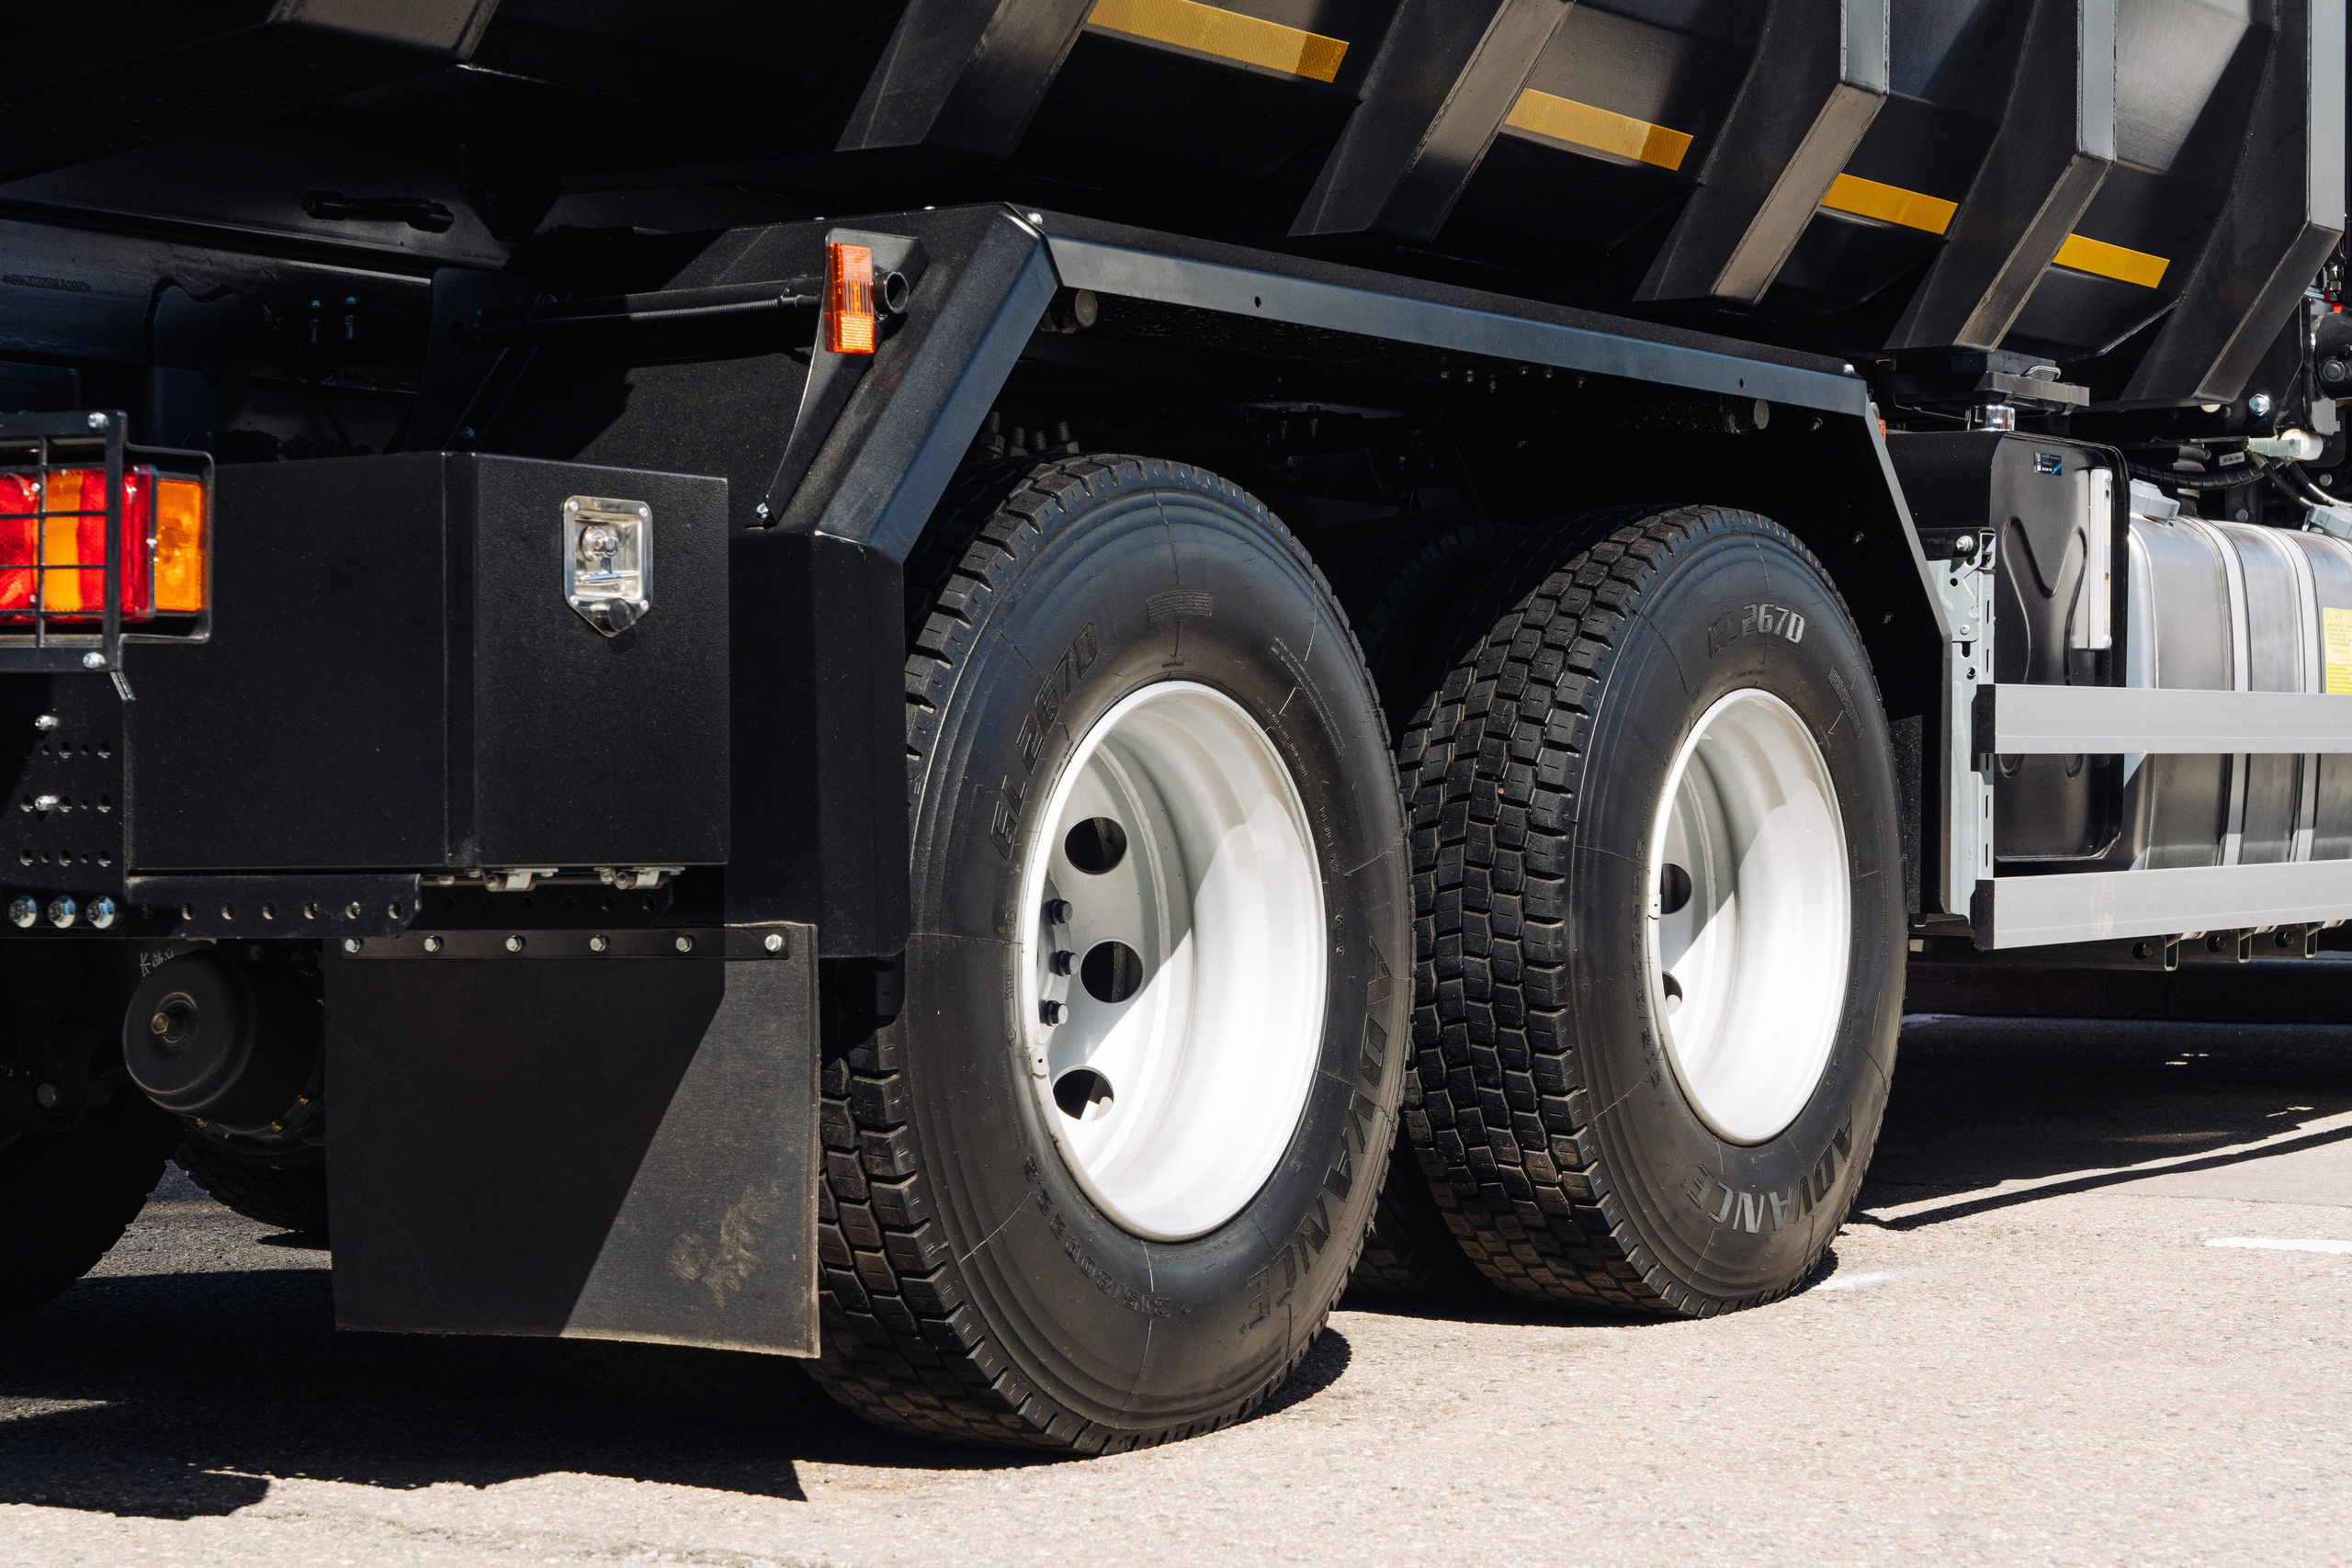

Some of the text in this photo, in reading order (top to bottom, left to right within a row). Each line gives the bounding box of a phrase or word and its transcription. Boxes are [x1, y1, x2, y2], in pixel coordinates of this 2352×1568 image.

[1709, 602, 1805, 659] GL 267D
[989, 774, 1028, 861] GL
[1016, 622, 1100, 774] 267D
[1246, 936, 1391, 1331] ADVANCE
[1688, 1100, 1853, 1235] ADVANCE
